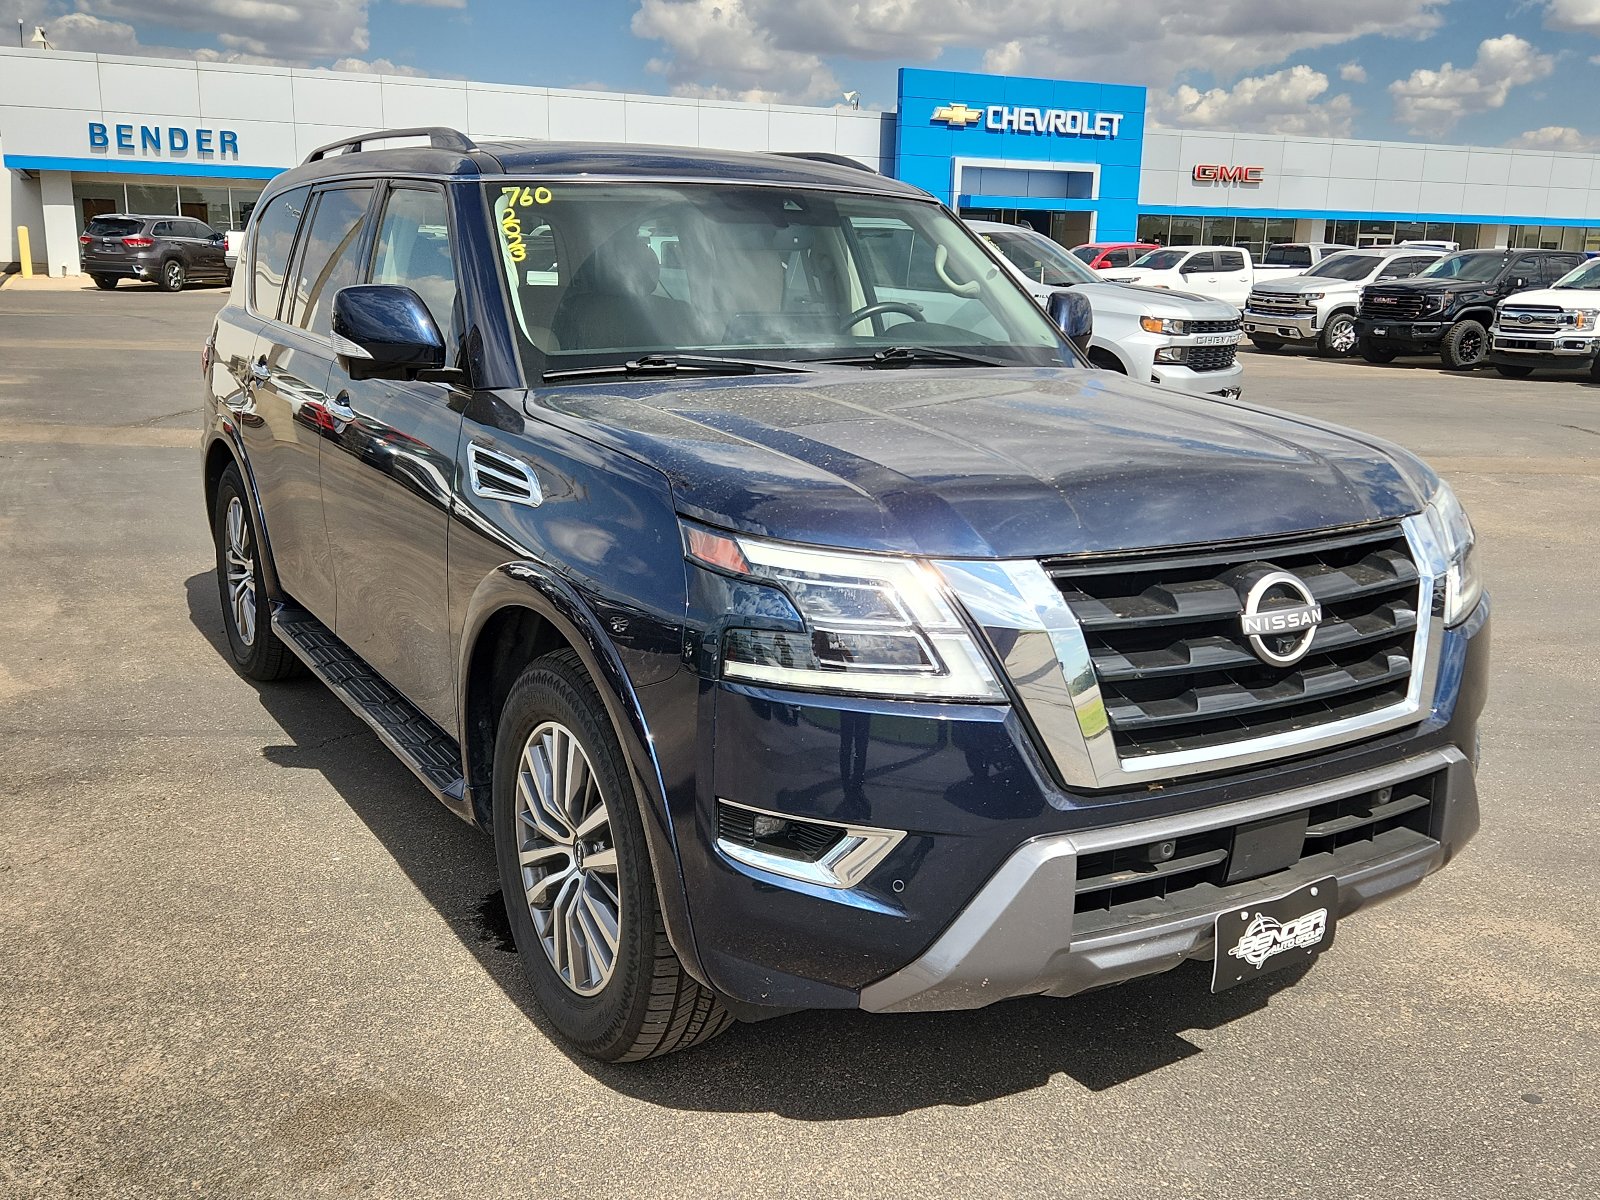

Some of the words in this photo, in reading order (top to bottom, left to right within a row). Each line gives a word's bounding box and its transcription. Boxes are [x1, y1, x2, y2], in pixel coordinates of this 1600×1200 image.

[986, 105, 1124, 136] CHEVROLET
[88, 122, 239, 155] BENDER
[1193, 163, 1265, 183] GMC
[501, 186, 552, 207] 760
[1245, 608, 1321, 633] NISSAN
[1237, 909, 1327, 958] BENDER
[1270, 940, 1296, 954] AUTO
